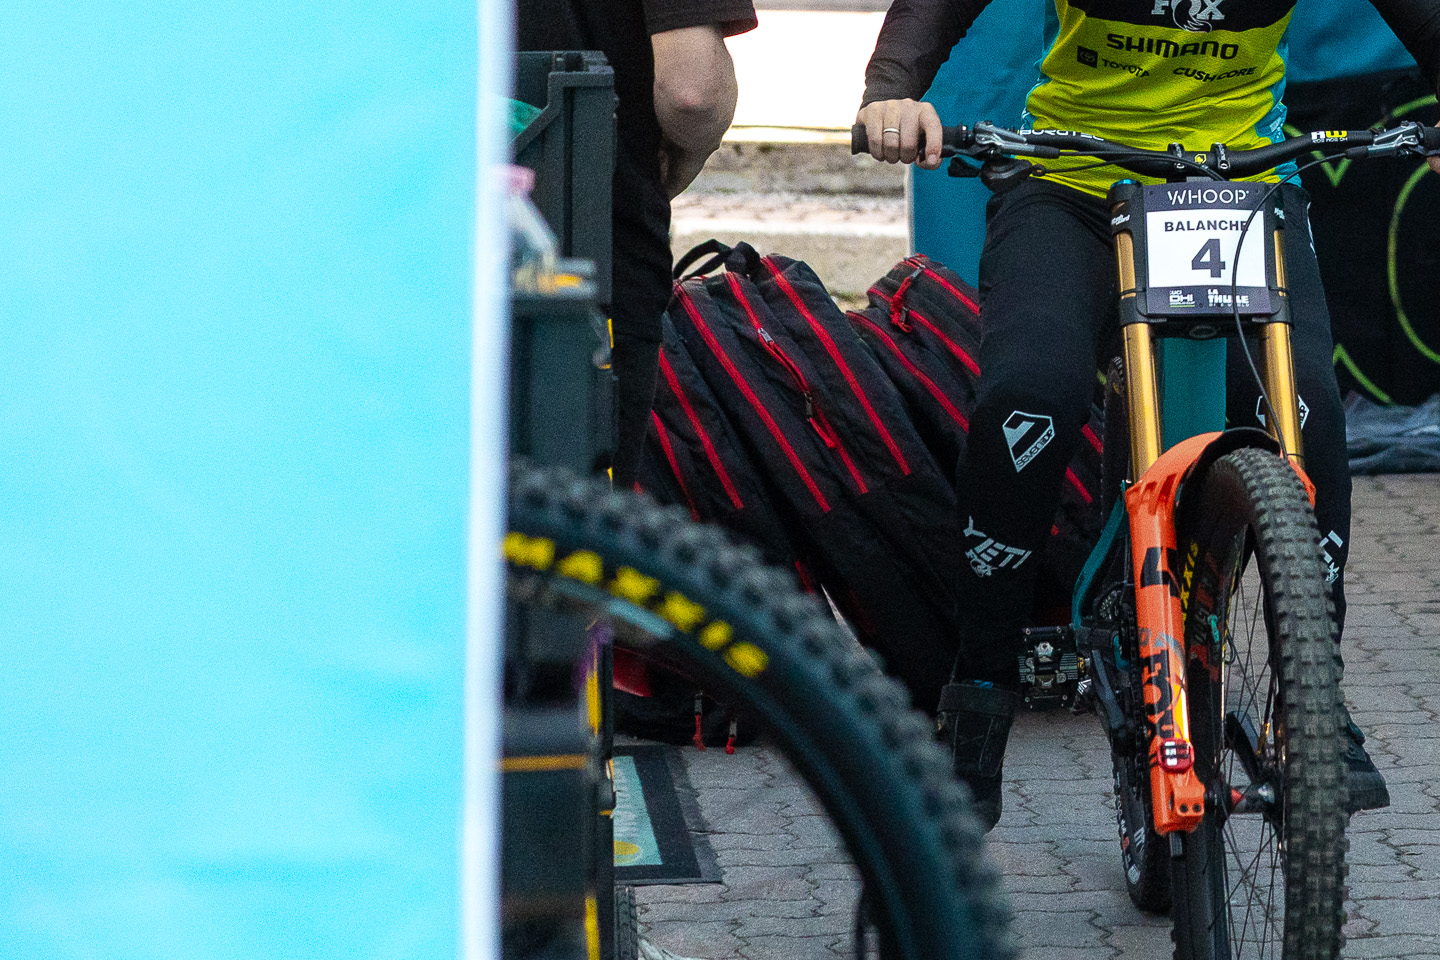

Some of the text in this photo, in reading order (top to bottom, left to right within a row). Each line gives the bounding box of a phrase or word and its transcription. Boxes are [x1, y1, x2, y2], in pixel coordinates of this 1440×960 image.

[1106, 33, 1240, 60] SHIMANO
[1102, 58, 1150, 78] TOYOTA
[1167, 189, 1247, 205] WHOOP
[1164, 220, 1249, 232] BALANCHE
[1191, 238, 1226, 278] 4
[1207, 294, 1249, 304] THULE
